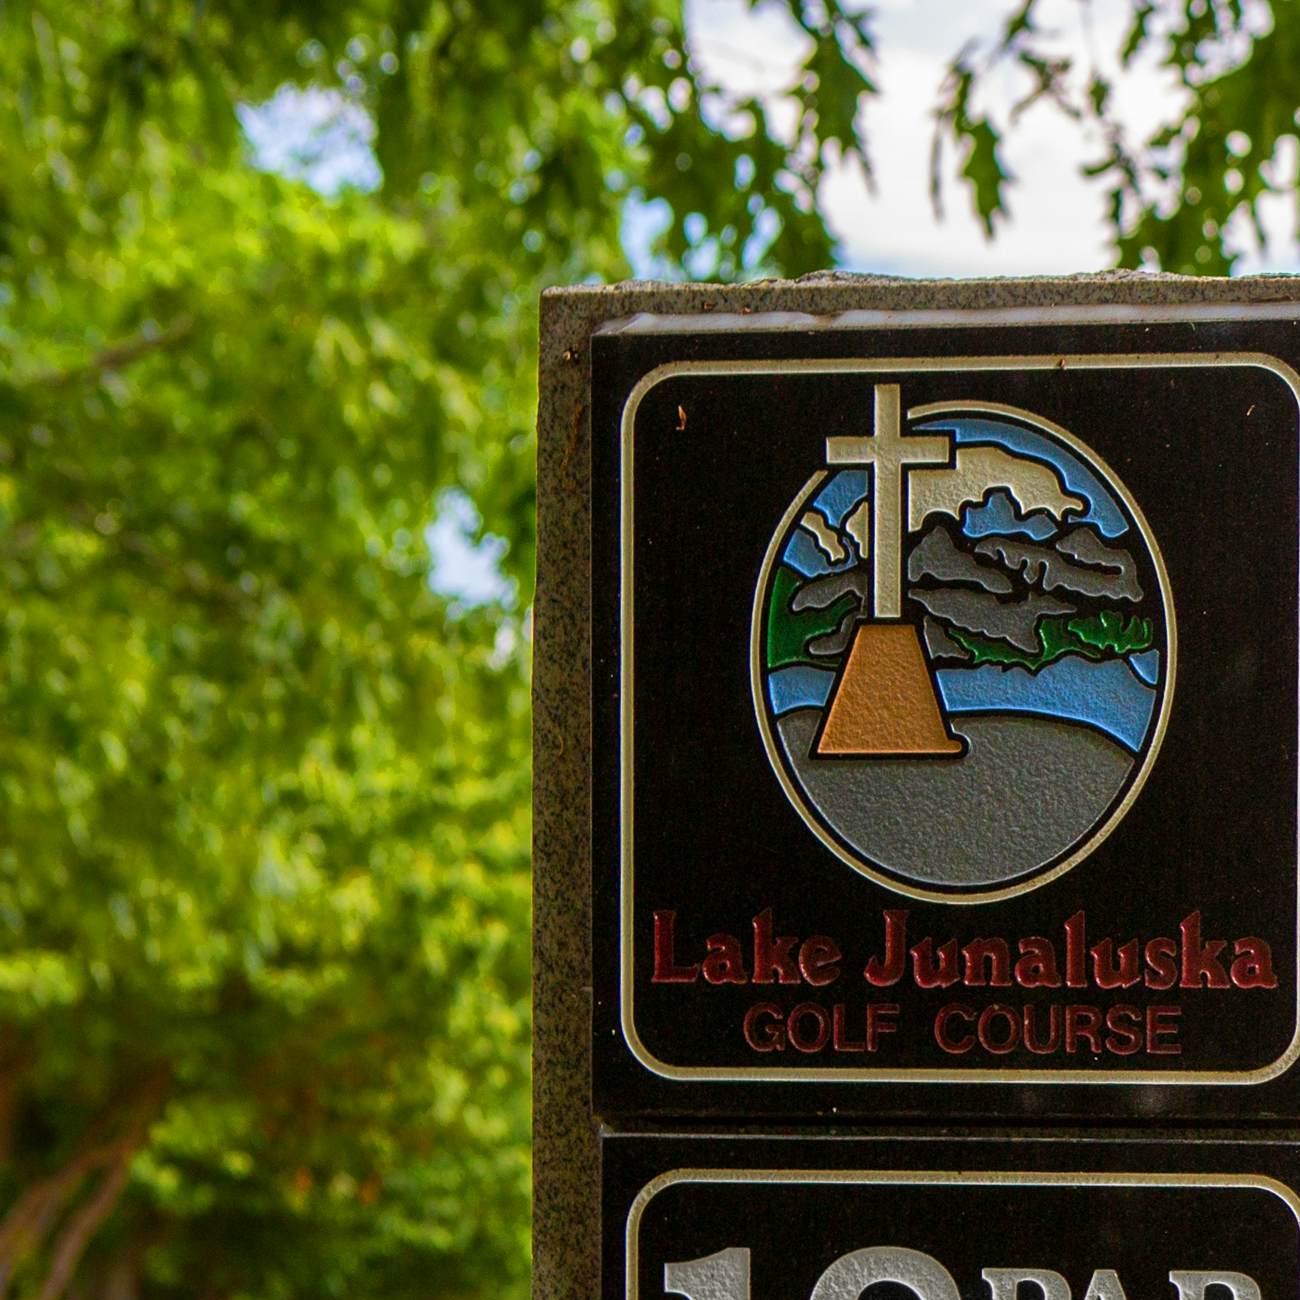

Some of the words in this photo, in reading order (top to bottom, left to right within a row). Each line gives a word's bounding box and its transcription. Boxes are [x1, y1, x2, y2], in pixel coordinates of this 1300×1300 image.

[651, 906, 842, 986] Lake
[863, 908, 1278, 989] Junaluska
[743, 1003, 900, 1054] GOLF
[933, 1003, 1182, 1055] COURSE
